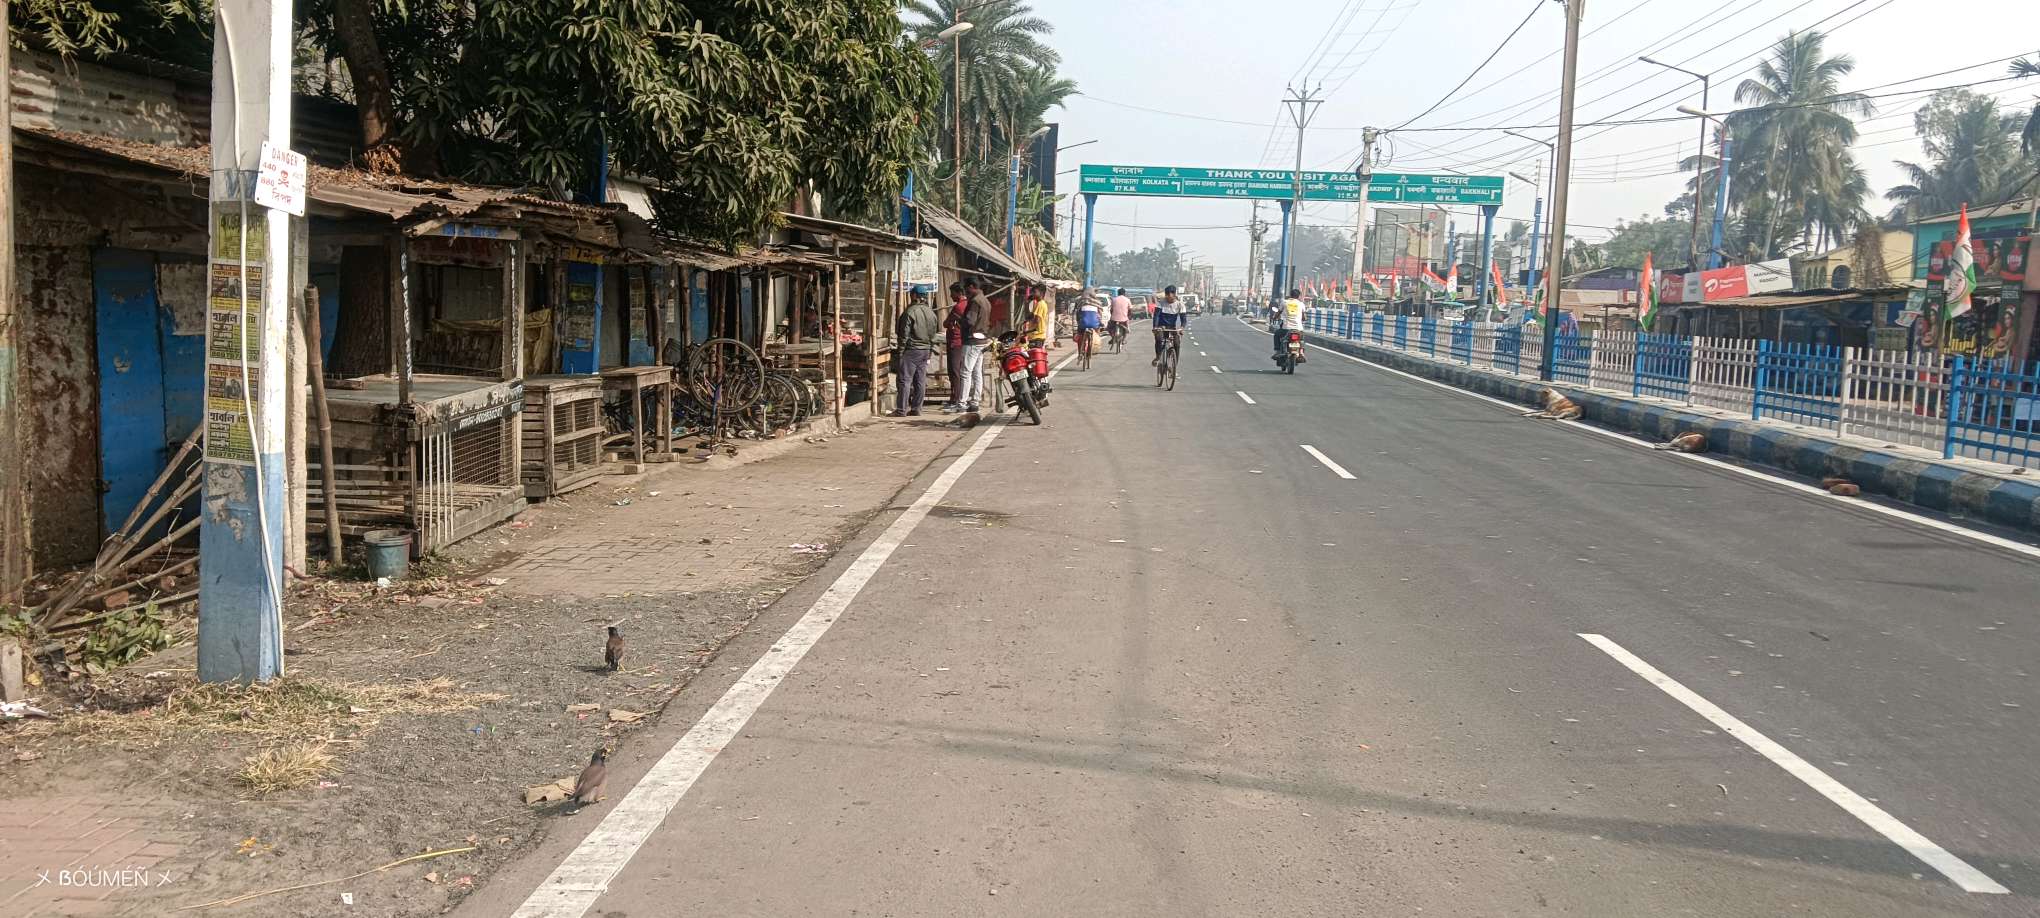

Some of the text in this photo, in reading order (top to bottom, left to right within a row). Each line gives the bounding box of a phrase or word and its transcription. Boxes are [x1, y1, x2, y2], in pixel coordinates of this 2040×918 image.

[272, 148, 298, 167] DANGER
[1206, 170, 1253, 179] THANK
[1257, 171, 1286, 180] YOU
[1142, 178, 1169, 186] KOLKATA
